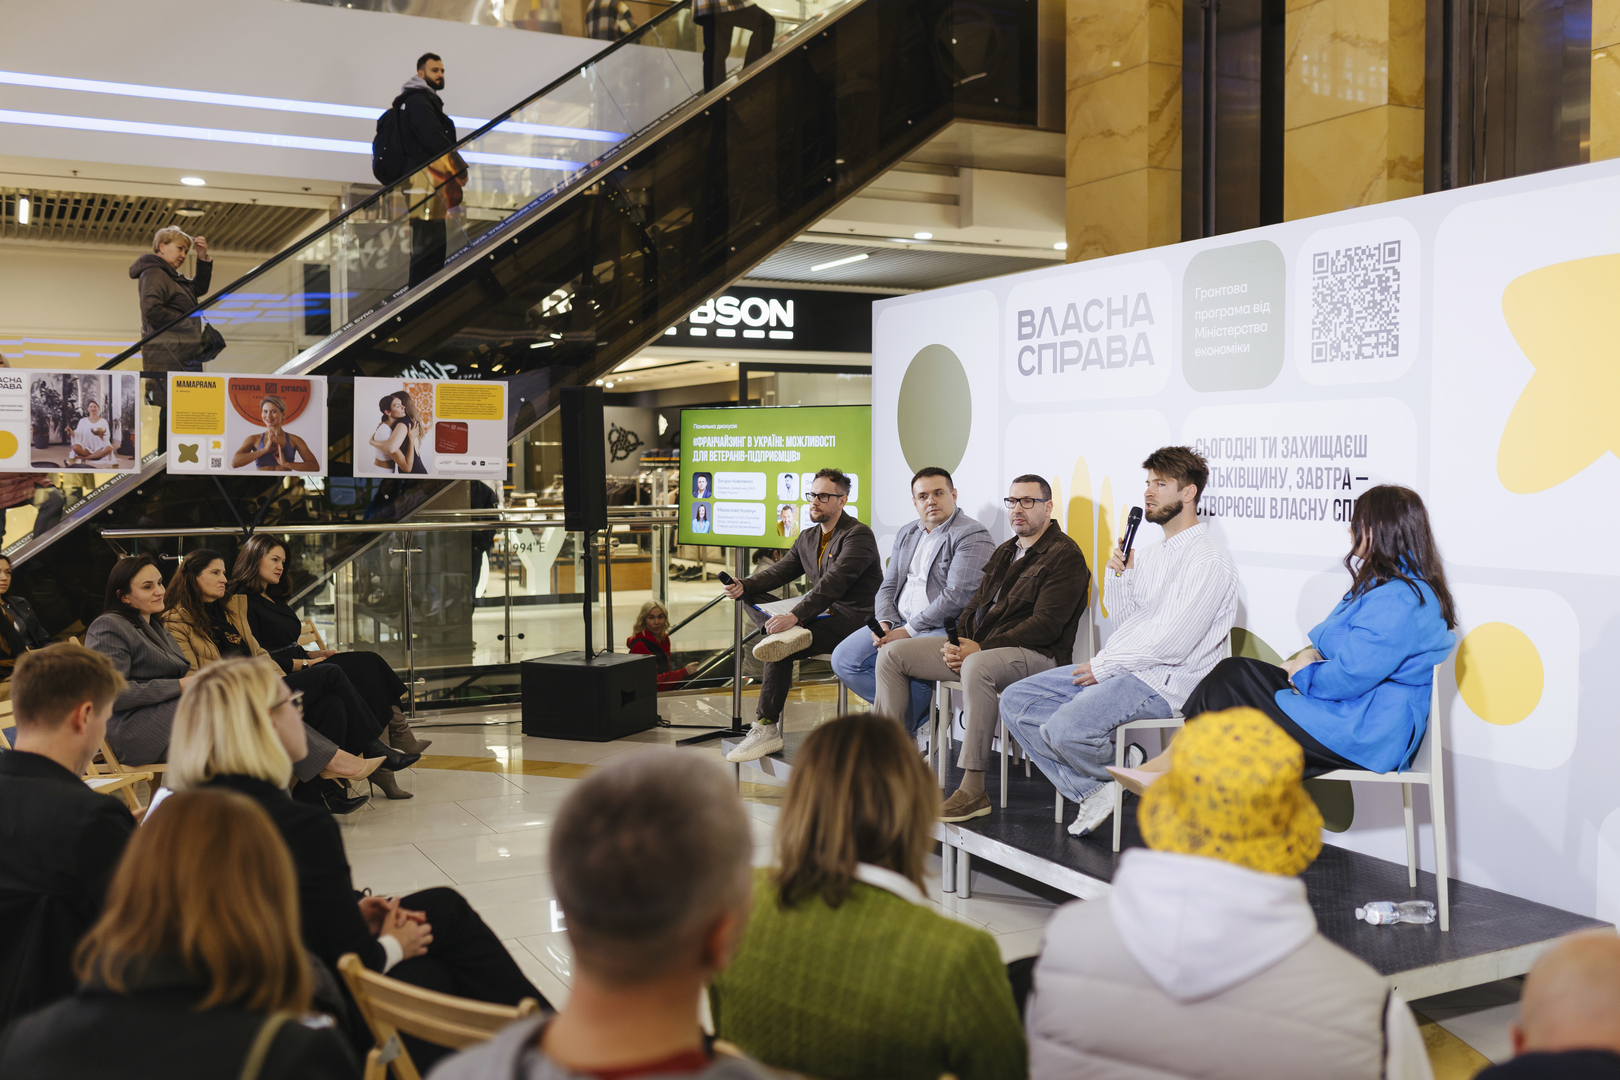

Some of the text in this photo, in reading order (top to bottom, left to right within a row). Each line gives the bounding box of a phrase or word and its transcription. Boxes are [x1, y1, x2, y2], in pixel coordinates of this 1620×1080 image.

[1196, 282, 1248, 301] Грантова
[1018, 292, 1155, 341] ВЛАСНА
[1195, 300, 1271, 322] програма від
[1195, 322, 1268, 340] Міністерства
[1018, 332, 1155, 376] СПРАВА
[1195, 342, 1250, 357] економіки
[176, 380, 217, 389] MAMAPRANA
[281, 385, 308, 393] prana
[693, 434, 836, 447] «ФРАНЧАЙЗИНГ В УКРАЇНІ: МОЖЛИВОСТІ
[1196, 434, 1368, 461] СЬОГОДНІ ТИ ЗАХИЩАЄШ
[692, 450, 800, 463] ДЛЯ ВЕТЕРАНІВ-ПІДПРИЄМЦІВ»
[1296, 467, 1352, 490] ЗАВТРА
[1270, 497, 1328, 521] ВЛАСНУ
[1333, 498, 1358, 522] СП
